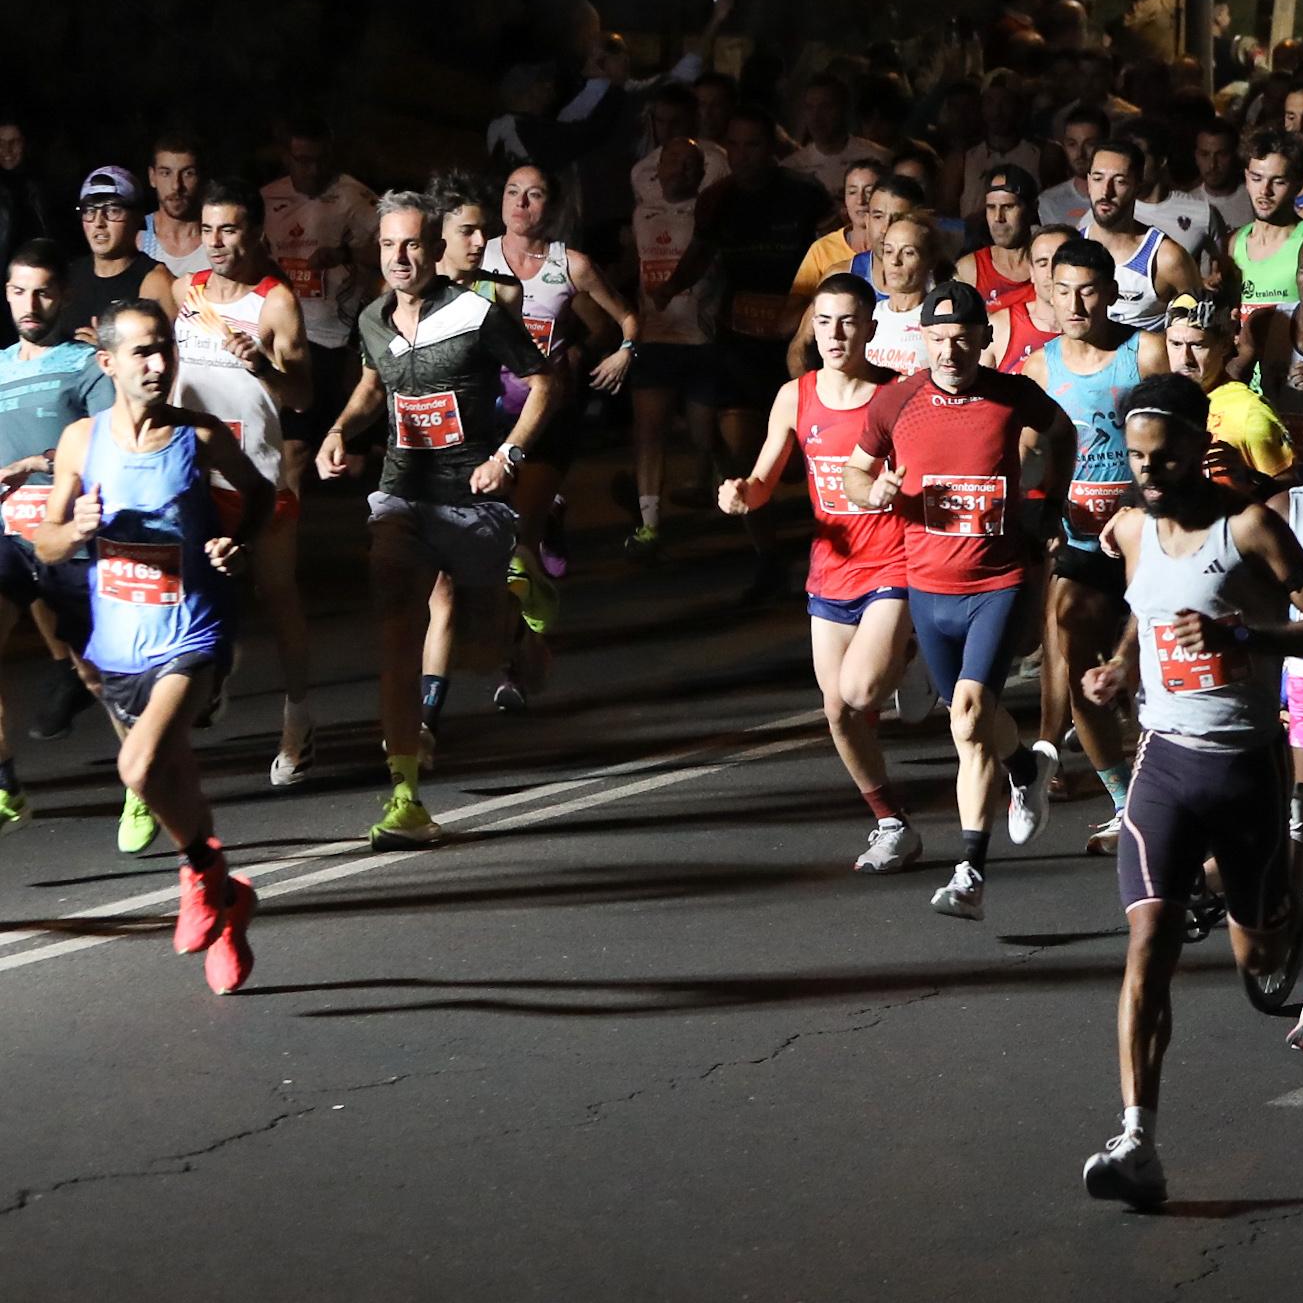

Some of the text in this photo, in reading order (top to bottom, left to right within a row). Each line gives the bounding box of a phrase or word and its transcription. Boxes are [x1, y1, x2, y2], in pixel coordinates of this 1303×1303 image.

[1255, 289, 1288, 298] training
[867, 348, 916, 364] PALOMA
[404, 398, 448, 411] Santander
[945, 481, 996, 492] Santander
[1083, 486, 1125, 496] Santande
[109, 560, 163, 580] 4169
